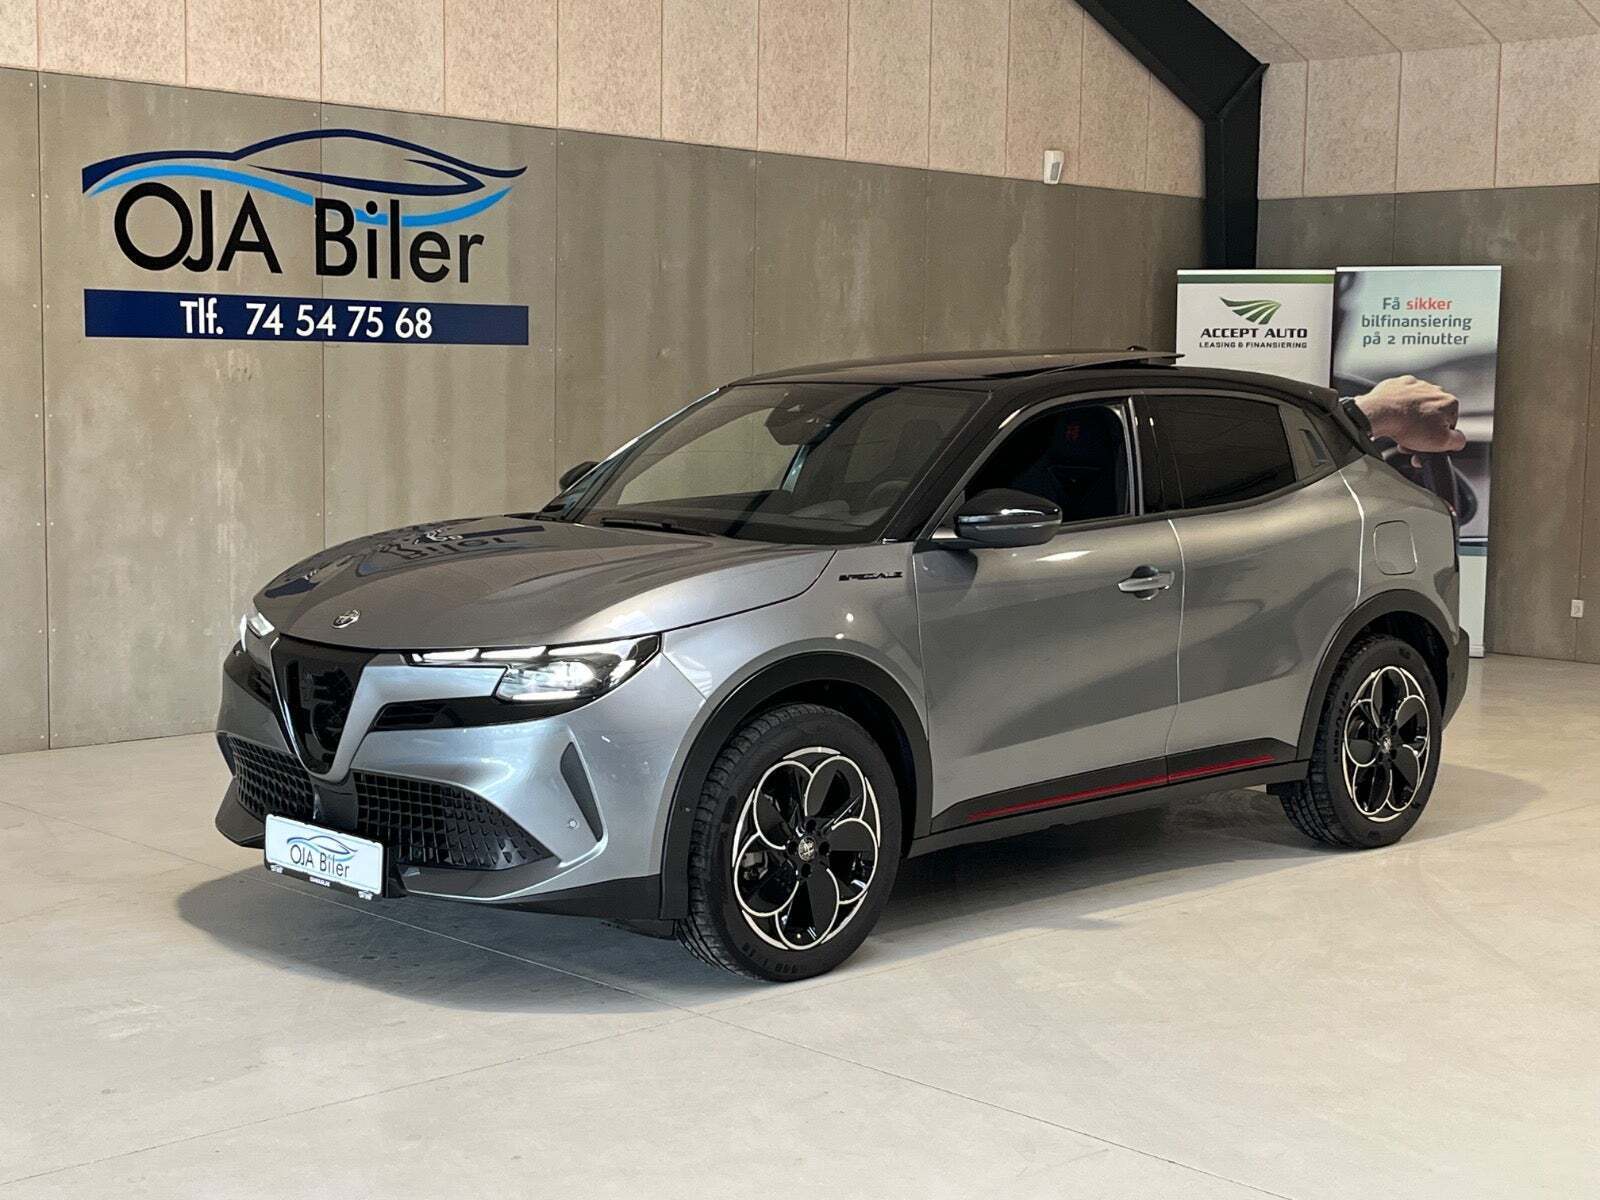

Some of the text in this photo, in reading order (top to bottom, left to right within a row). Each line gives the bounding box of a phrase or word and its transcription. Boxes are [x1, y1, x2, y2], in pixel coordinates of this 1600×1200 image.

[114, 181, 484, 284] OJA Biler
[1382, 296, 1452, 310] Få sikker
[180, 297, 433, 340] Tlf. 74 54 75 68
[1361, 314, 1472, 331] bilfinansiering
[1200, 327, 1308, 339] ACCEPT AUTO
[1362, 331, 1469, 348] på 2 minutter
[1199, 341, 1236, 349] LEASING
[1246, 341, 1308, 349] FINANSIERING
[290, 844, 350, 878] OJA Biler
